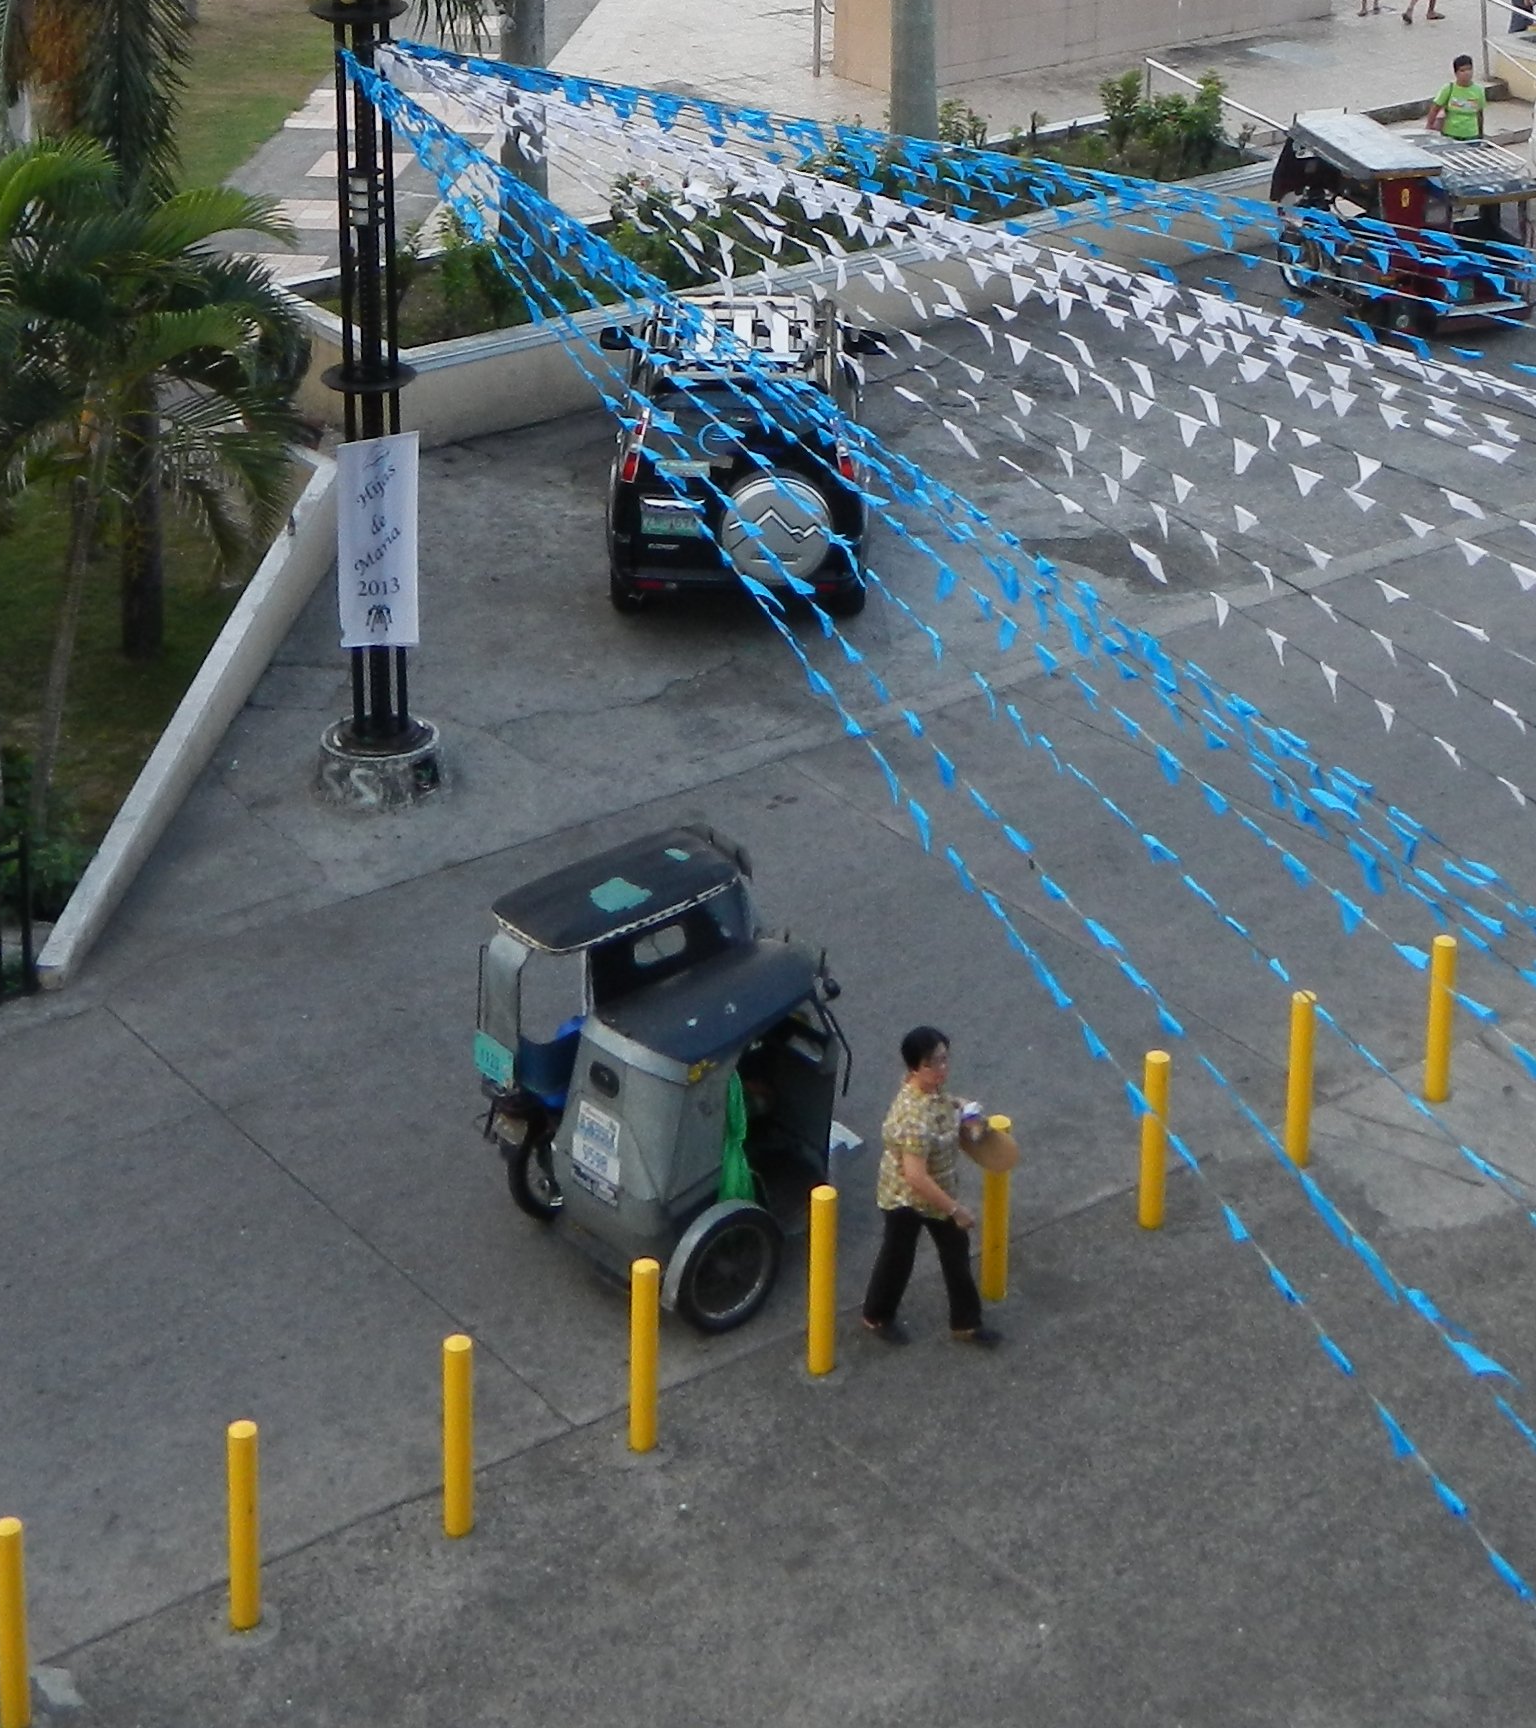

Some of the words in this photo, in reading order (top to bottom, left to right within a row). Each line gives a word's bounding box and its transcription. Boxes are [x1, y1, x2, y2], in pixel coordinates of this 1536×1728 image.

[371, 513, 385, 535] de
[354, 527, 400, 576] Maria
[357, 576, 400, 597] 2013
